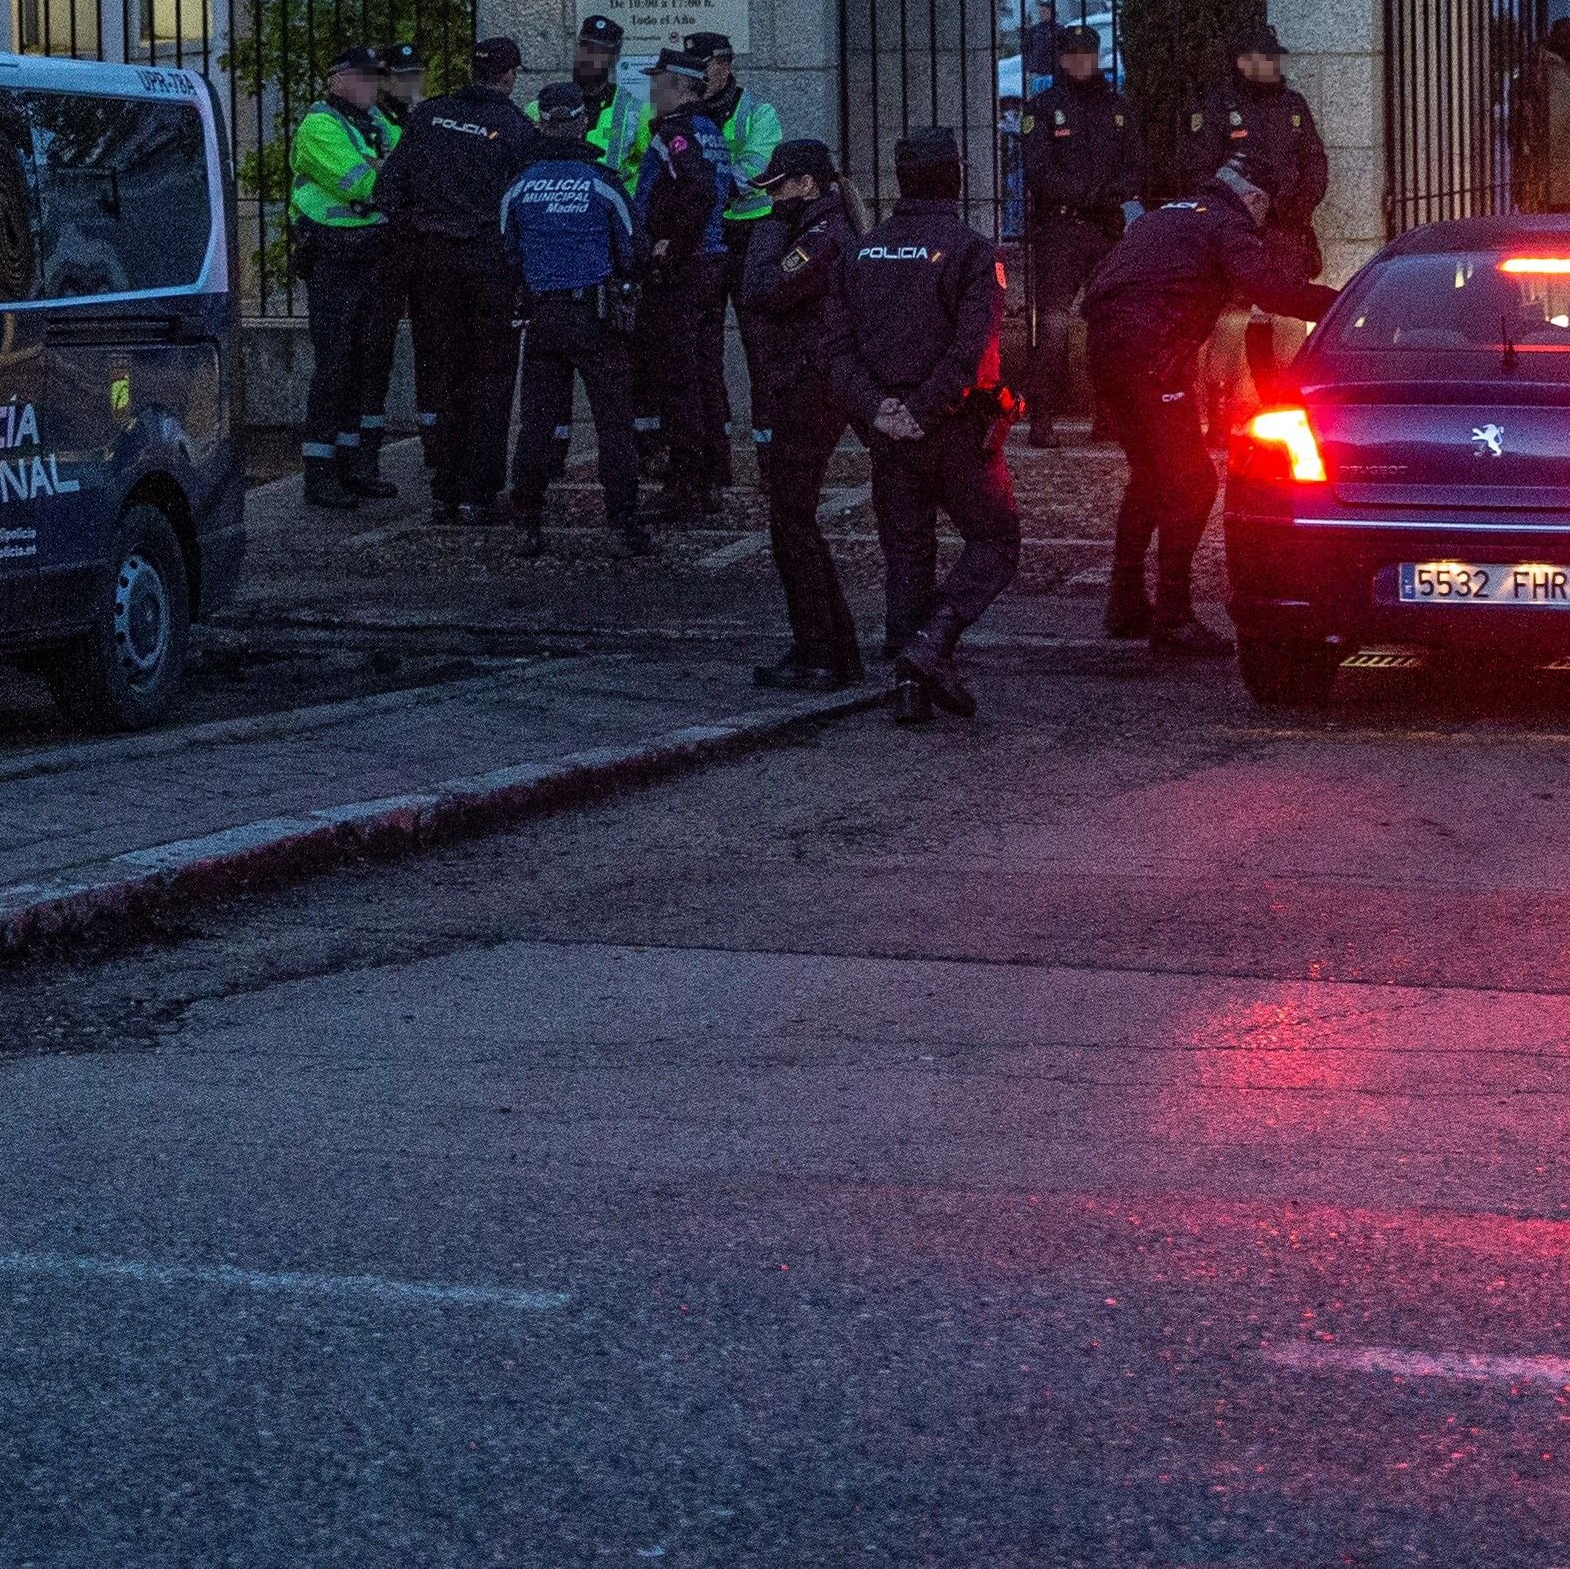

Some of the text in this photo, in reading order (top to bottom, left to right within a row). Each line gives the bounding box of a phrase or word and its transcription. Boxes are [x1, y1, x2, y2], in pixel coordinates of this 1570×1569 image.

[632, 13, 696, 25] Todo el Año
[523, 177, 591, 192] POLICÍA
[522, 191, 590, 204] MUNICIPAL
[546, 202, 588, 213] Madrid
[858, 246, 928, 260] POLICIA
[1417, 569, 1568, 600] 5532 FHR
